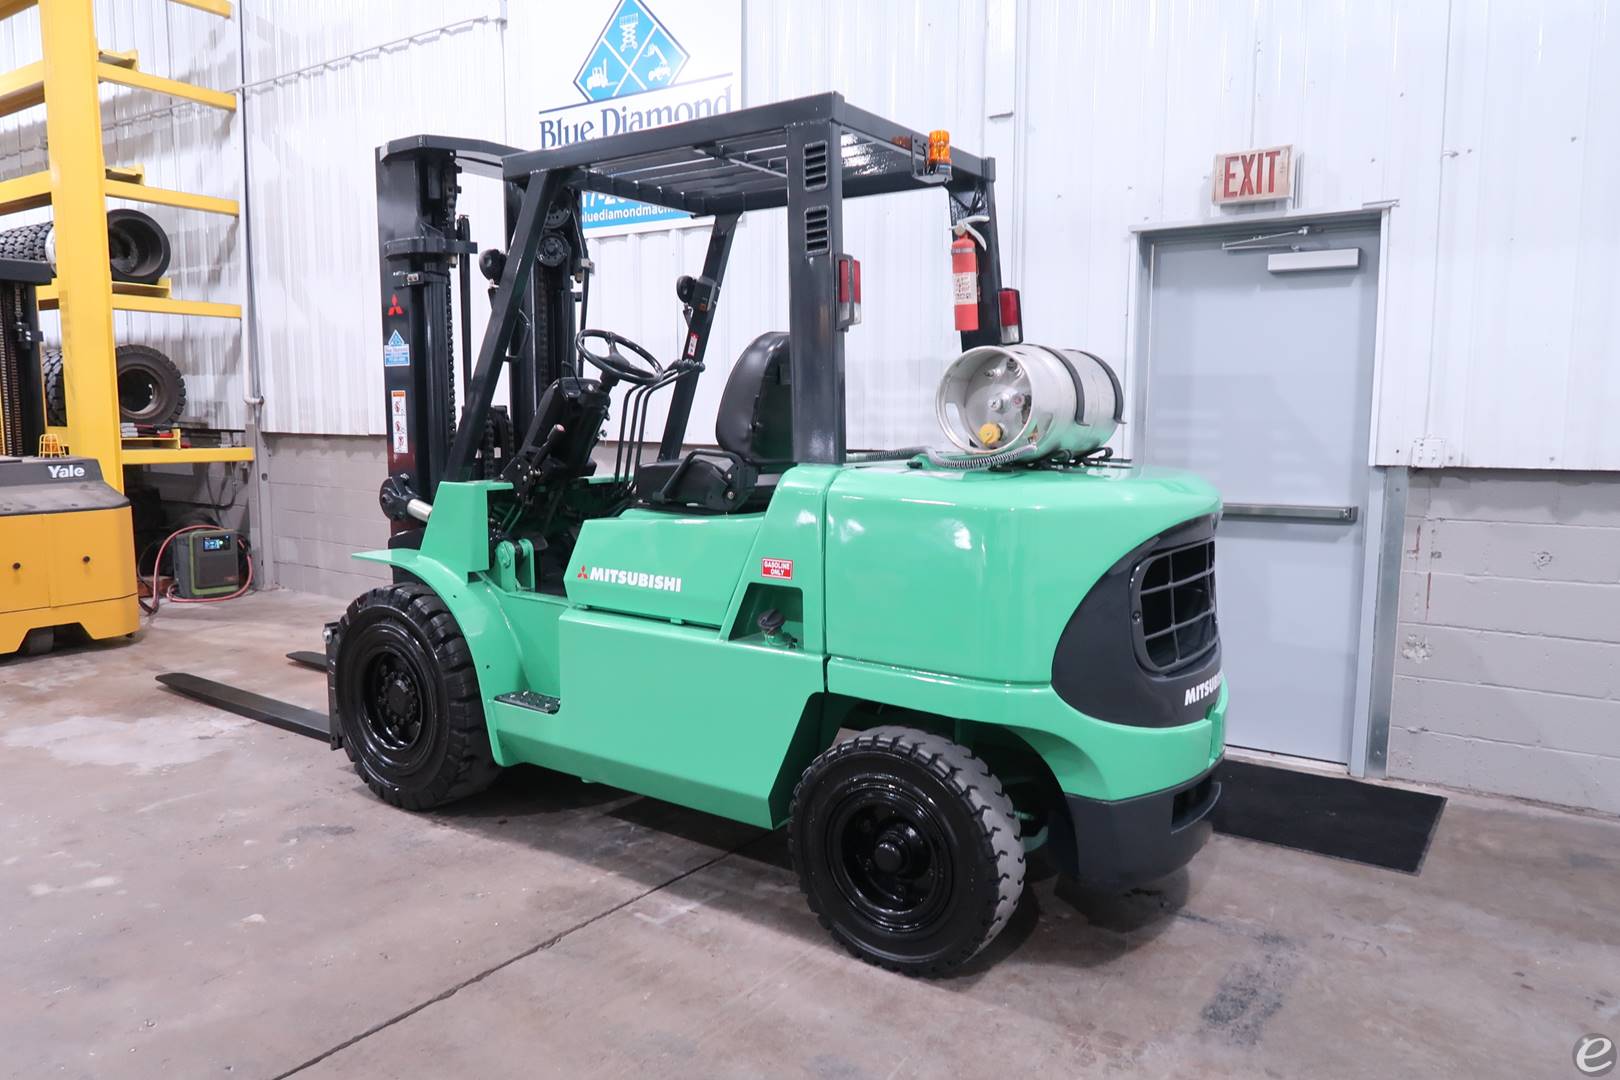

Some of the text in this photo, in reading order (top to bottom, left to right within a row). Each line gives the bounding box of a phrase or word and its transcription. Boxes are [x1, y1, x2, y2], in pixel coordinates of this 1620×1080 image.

[540, 84, 734, 150] Blue Diamond
[1224, 150, 1280, 198] EXIT
[48, 464, 86, 478] Yale
[763, 560, 790, 570] GASOLINE
[770, 567, 785, 576] ONLY
[589, 566, 683, 593] MITSUBISHI
